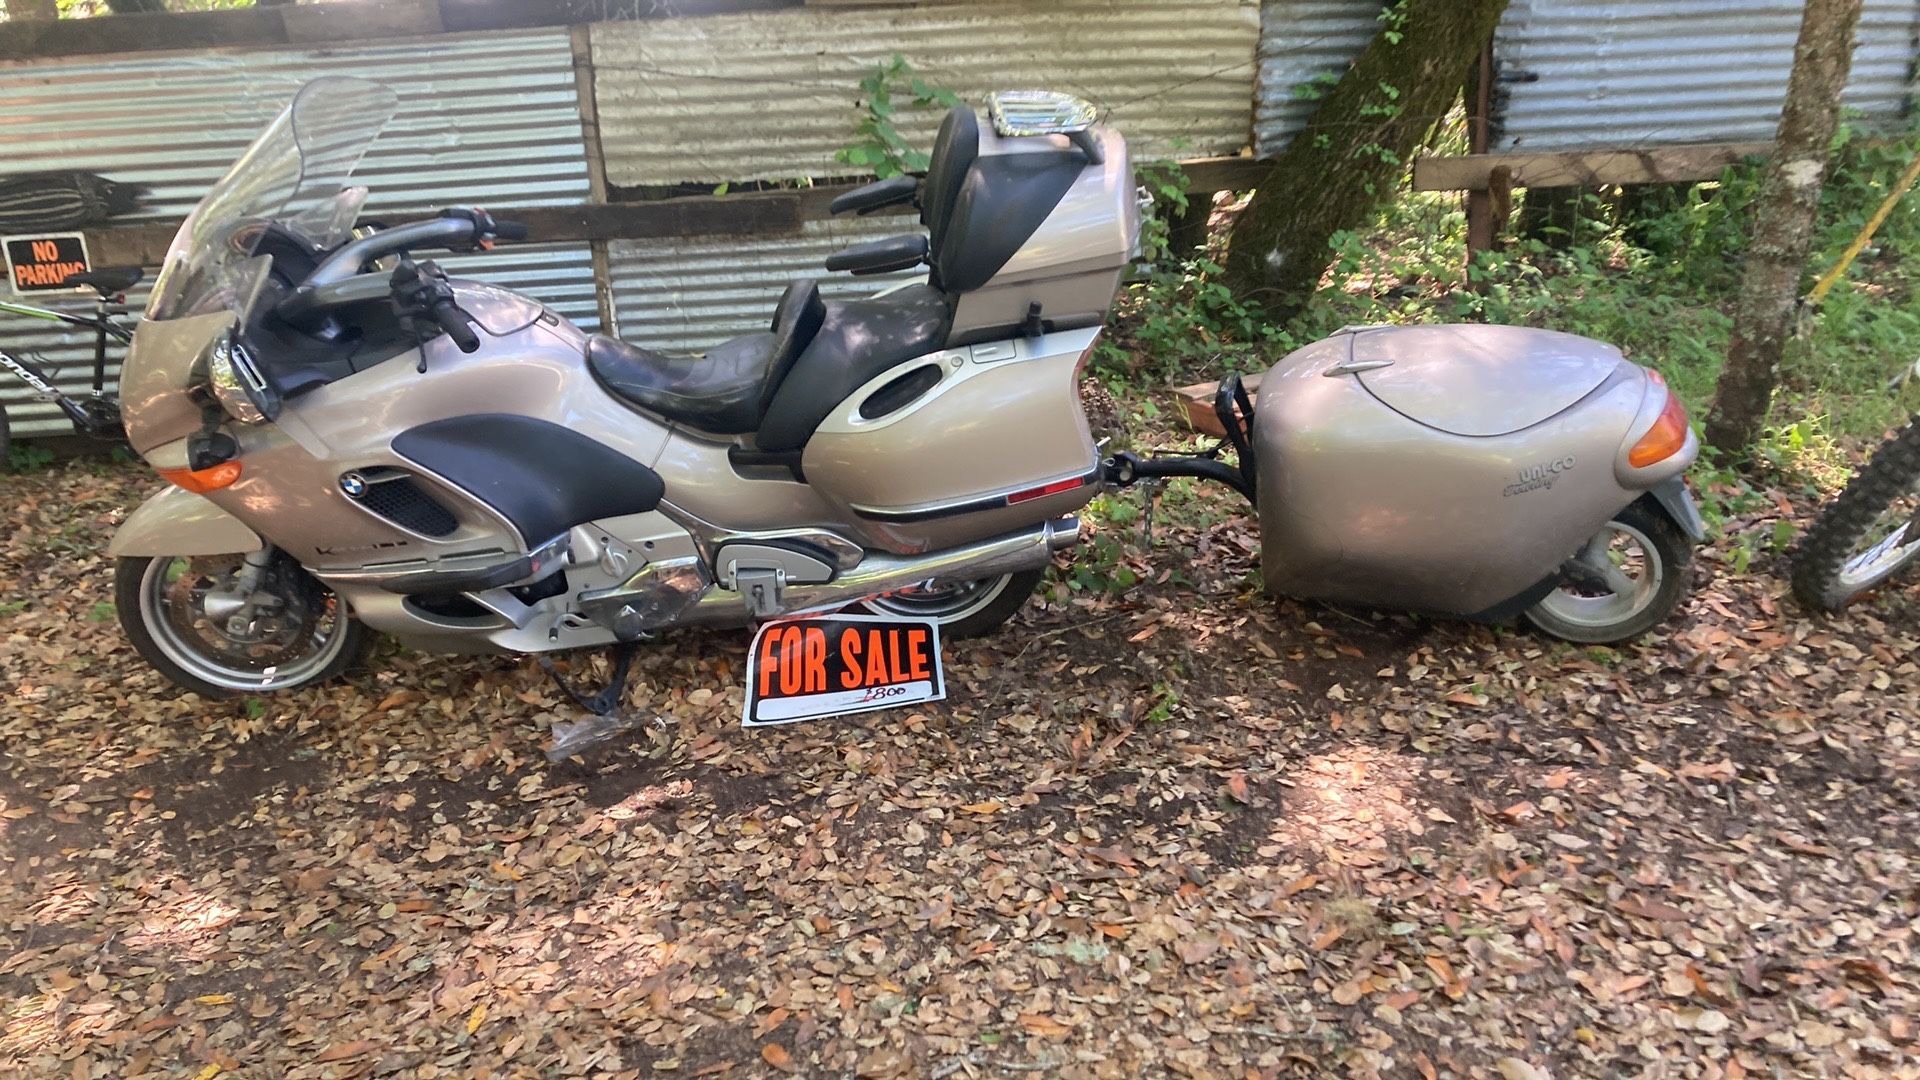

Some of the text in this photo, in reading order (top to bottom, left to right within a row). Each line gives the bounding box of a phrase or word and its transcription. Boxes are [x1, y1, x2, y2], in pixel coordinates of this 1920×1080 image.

[32, 240, 59, 262] NO
[759, 625, 931, 697] FOR SALE
